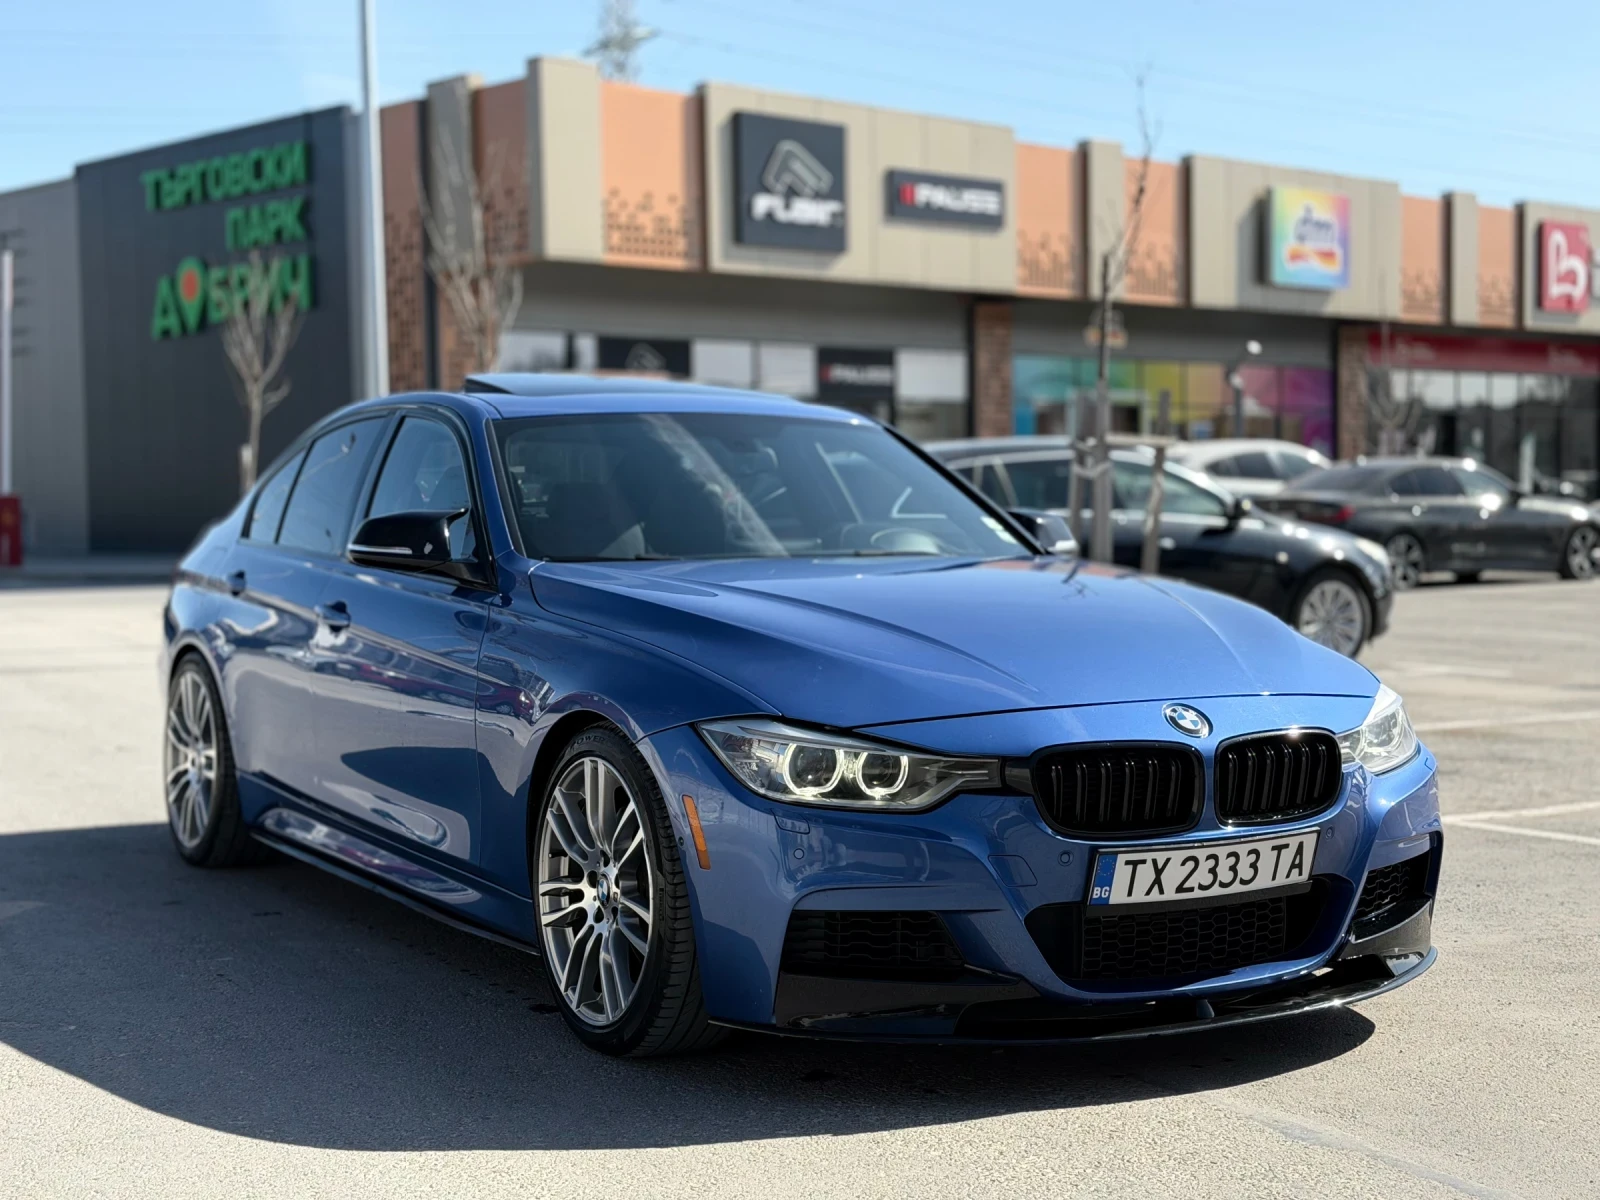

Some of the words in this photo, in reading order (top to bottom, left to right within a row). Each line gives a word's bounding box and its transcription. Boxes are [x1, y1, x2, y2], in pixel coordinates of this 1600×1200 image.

[140, 142, 307, 212] ТЪРГОВСКИ
[225, 196, 305, 250] ПАРК
[1092, 886, 1110, 899] BG
[1124, 857, 1172, 898] TX
[1174, 848, 1261, 894] 2333
[1270, 840, 1304, 882] TA
